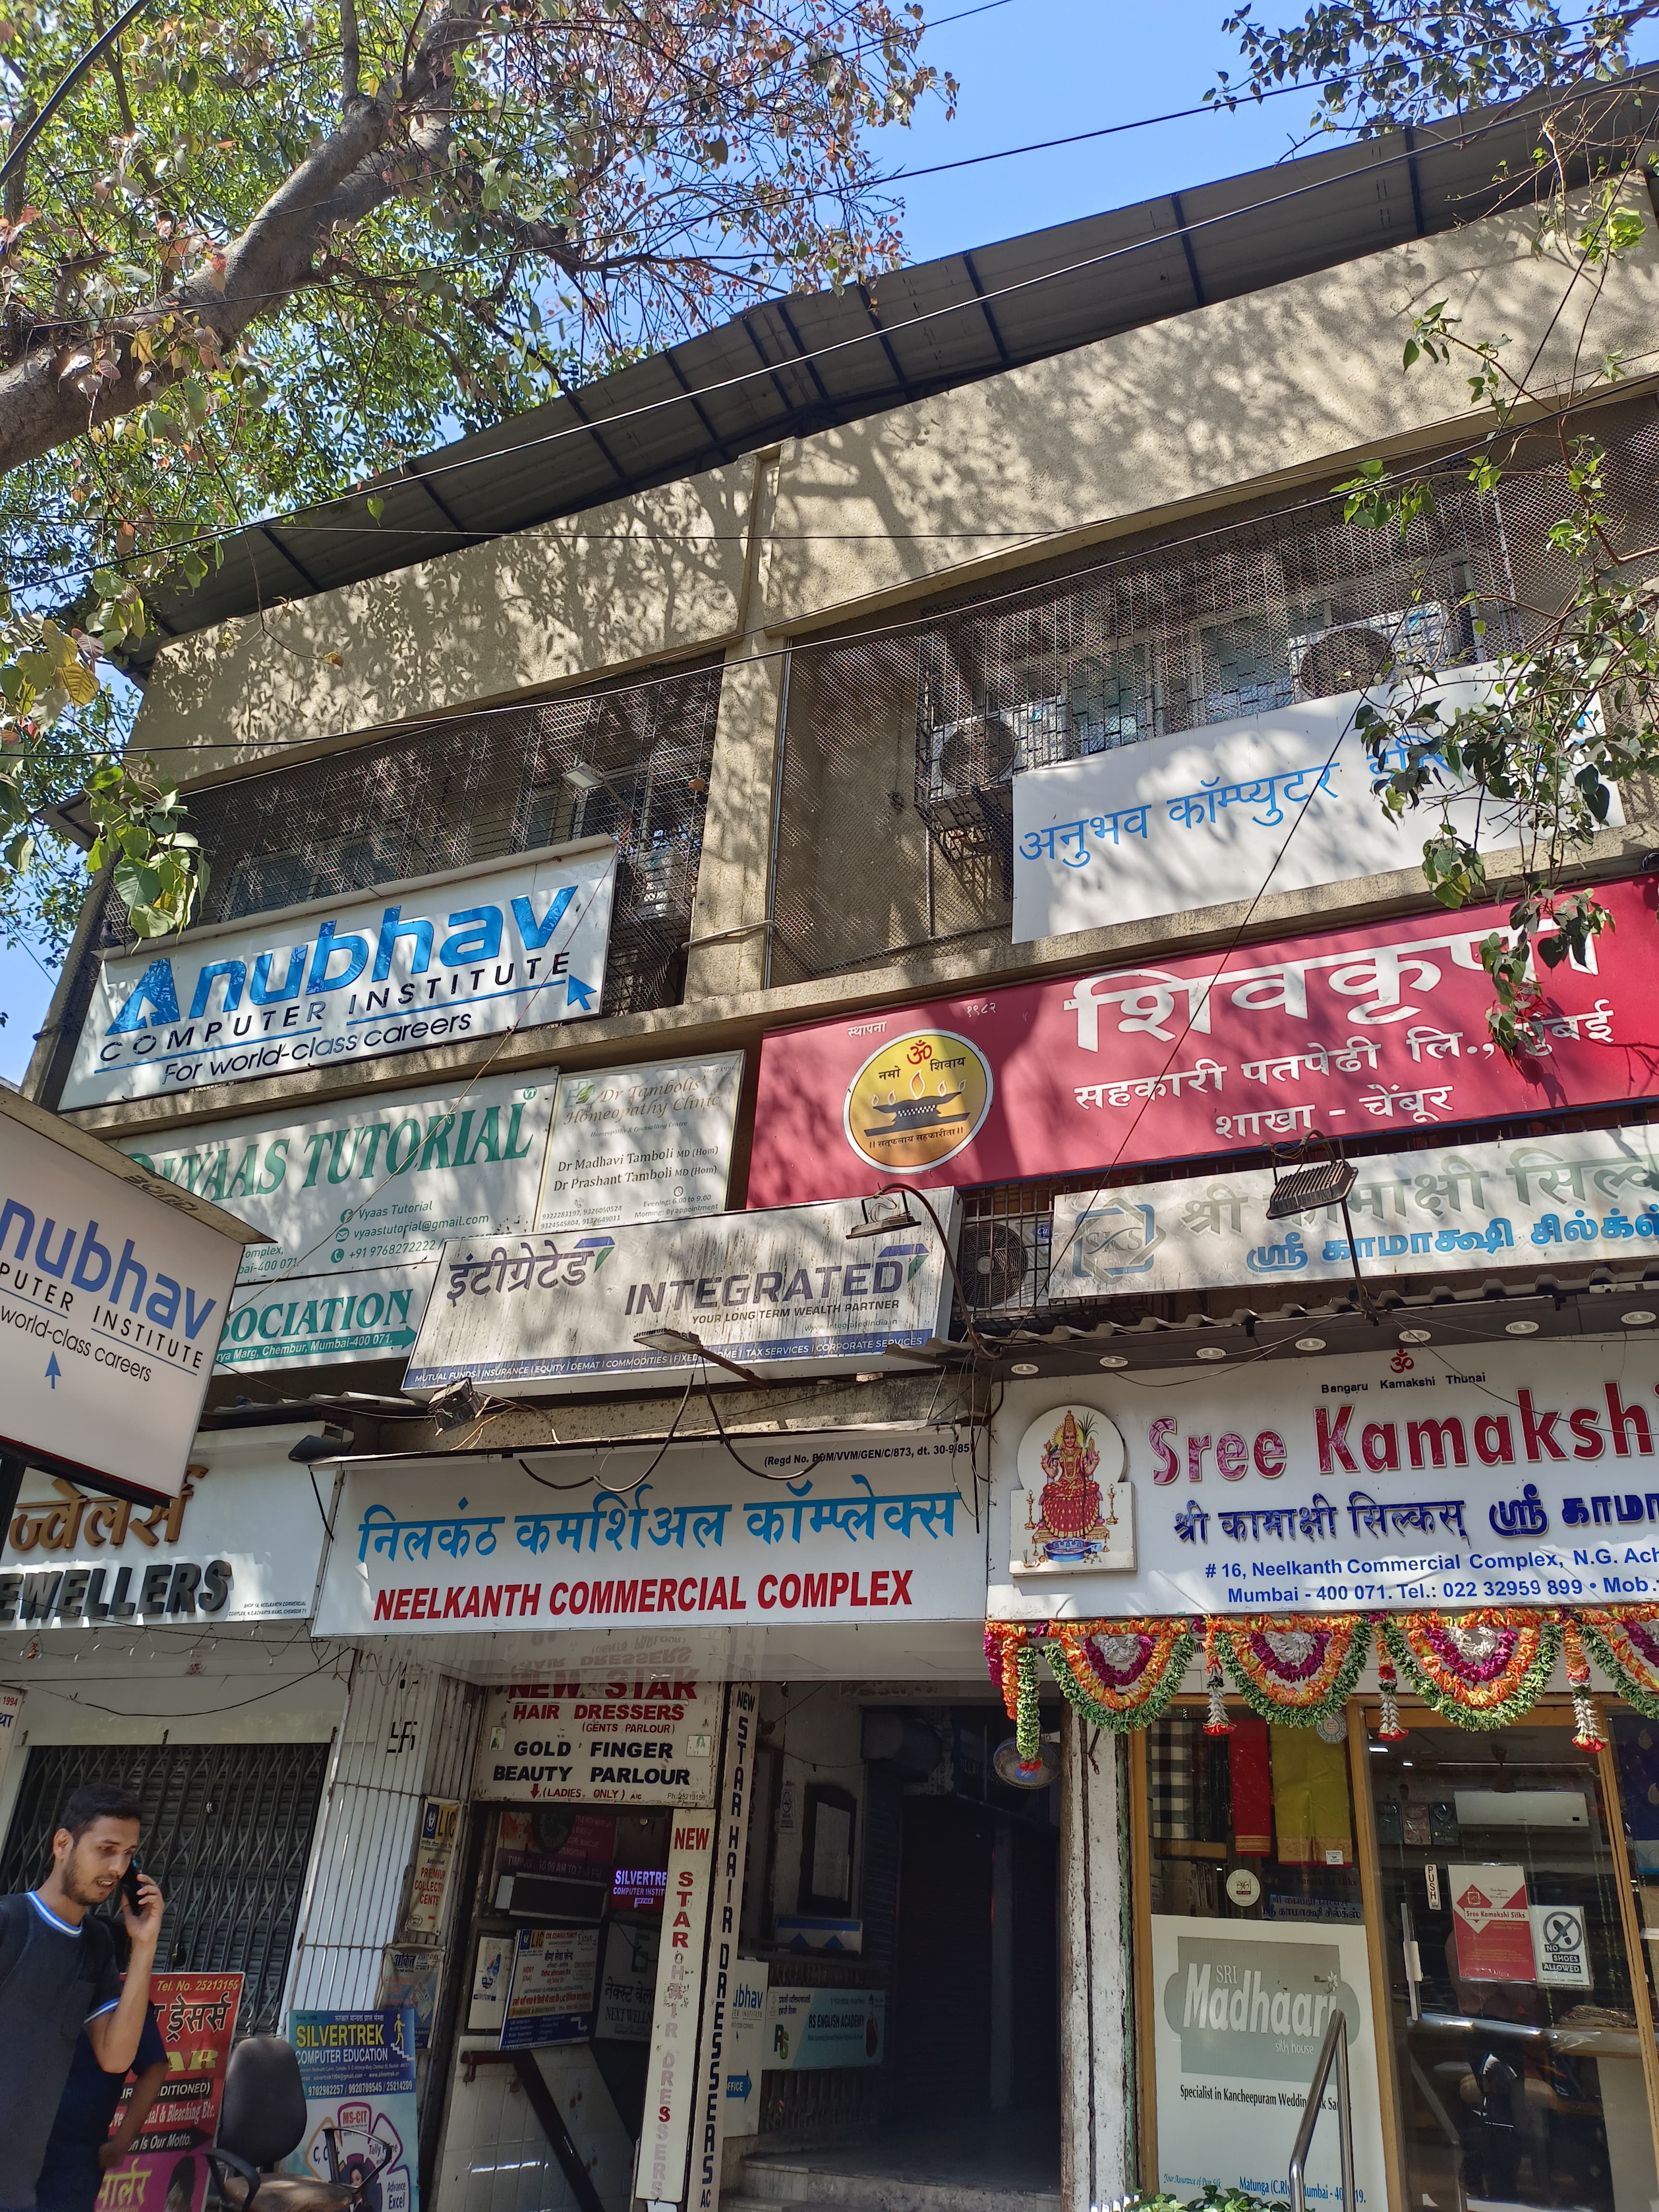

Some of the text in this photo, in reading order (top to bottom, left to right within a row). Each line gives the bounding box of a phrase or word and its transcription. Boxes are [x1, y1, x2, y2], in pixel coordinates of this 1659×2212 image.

[1019, 805, 1152, 867] अनुभव
[106, 885, 578, 1036] Anubhav
[99, 951, 571, 1062] COMPUTER INSTITUTE
[848, 1021, 887, 1038] स्थापना
[163, 1012, 471, 1085] For world-class careers
[878, 1057, 966, 1080] नमो शिवाय
[1074, 1058, 1228, 1111] सहकारी
[1242, 1034, 1380, 1085] पतपेढी
[601, 1088, 623, 1103] Dr
[563, 1094, 720, 1125] Homeopathy Clinic
[1215, 1082, 1454, 1140] शाखा चेंबूर
[302, 1102, 534, 1188] TUTORIAL
[558, 1161, 572, 1172] Dr
[575, 1154, 624, 1170] Madhavi
[627, 1148, 673, 1163] Tamboli
[676, 1149, 690, 1157] MD
[554, 1180, 568, 1191] Dr
[571, 1173, 622, 1189] Prashant
[625, 1166, 672, 1182] Tamboli
[675, 1168, 688, 1177] MD
[359, 1201, 433, 1220] Vyaas Tutorial
[675, 1203, 718, 1214] appointment
[354, 1213, 489, 1240] vyaastutorial@gmail.com
[349, 1239, 436, 1259] +91 9768272222
[625, 1257, 903, 1316] INTEGRATED
[692, 1299, 900, 1325] YOUR LONG TERM WEALTH PARTNER
[1, 1305, 152, 1382] world-class careers
[93, 1305, 204, 1369] INSTITUTE
[233, 1346, 259, 1361] Marg,
[262, 1342, 308, 1357] Chembur,
[311, 1334, 371, 1353] Mumbai-400
[415, 1373, 447, 1382] MUTUAL
[482, 1366, 529, 1378] INSURANCE
[535, 1363, 565, 1375] EQUITY
[571, 1361, 600, 1370] DEMAT
[606, 1356, 667, 1368] COMMODITIES
[746, 1348, 763, 1357] TAX
[765, 1345, 809, 1356] SERVICES
[816, 1341, 874, 1352] CORPORATE
[876, 1337, 923, 1348] SERVICES
[1322, 1372, 1486, 1394] Bangaru Kamakshi Thunai
[1151, 1381, 1659, 1485] Sree Kamaksh
[794, 1455, 809, 1464] No.
[917, 1447, 930, 1455] dt.
[357, 1496, 506, 1563] निलकंठ
[1174, 1500, 1209, 1545] श्री
[1218, 1493, 1337, 1541] कामाक्षी
[1205, 1548, 1617, 1580] # 16, Neelkanth Commercial Complex, N.G.
[0, 1560, 233, 1621] EWELLERS
[374, 1569, 914, 1621] NEELKANTH COMMERCIAL COMPLEX
[1228, 1579, 1582, 1602] Mumbai 400 071. Tel.: 022 32959 899
[508, 1681, 697, 1700] NEW STAR
[736, 1689, 756, 1713] NEW
[513, 1705, 684, 1721] HAIR DRESSERS
[582, 1721, 675, 1734] (GENTS PARLOUR)
[514, 1741, 673, 1759] GOLD FINGER
[493, 1766, 690, 1785] BEAUTY PARLOUR
[613, 1887, 644, 1896] COMPUTER
[672, 1827, 710, 1948] NEW STAR
[1428, 1866, 1437, 1900] PUSH
[530, 1932, 544, 1948] LIC
[702, 1716, 749, 2185] STAR HAIR DRESSERS
[1216, 1964, 1238, 1984] SRI
[1544, 1964, 1580, 1973] ALLOWED
[157, 1979, 239, 1991] Tel. No. 25213156
[1183, 1962, 1337, 2037] Madhaari
[817, 2014, 839, 2028] ENGLISH
[296, 2024, 384, 2048] SILVERTREK
[295, 2048, 387, 2064] COMPUTER EDUCATION
[1291, 2041, 1314, 2055] house
[1180, 2085, 1277, 2106] Specialist in Kancheepuram
[166, 2101, 215, 2124] Bleaching Etc.
[343, 2111, 367, 2124] MS-CIT
[150, 2135, 165, 2150] Our
[369, 2144, 381, 2157] Tally
[387, 2181, 406, 2193] Advance
[1239, 2176, 1269, 2194] Matunga
[389, 2192, 405, 2210] Excel
